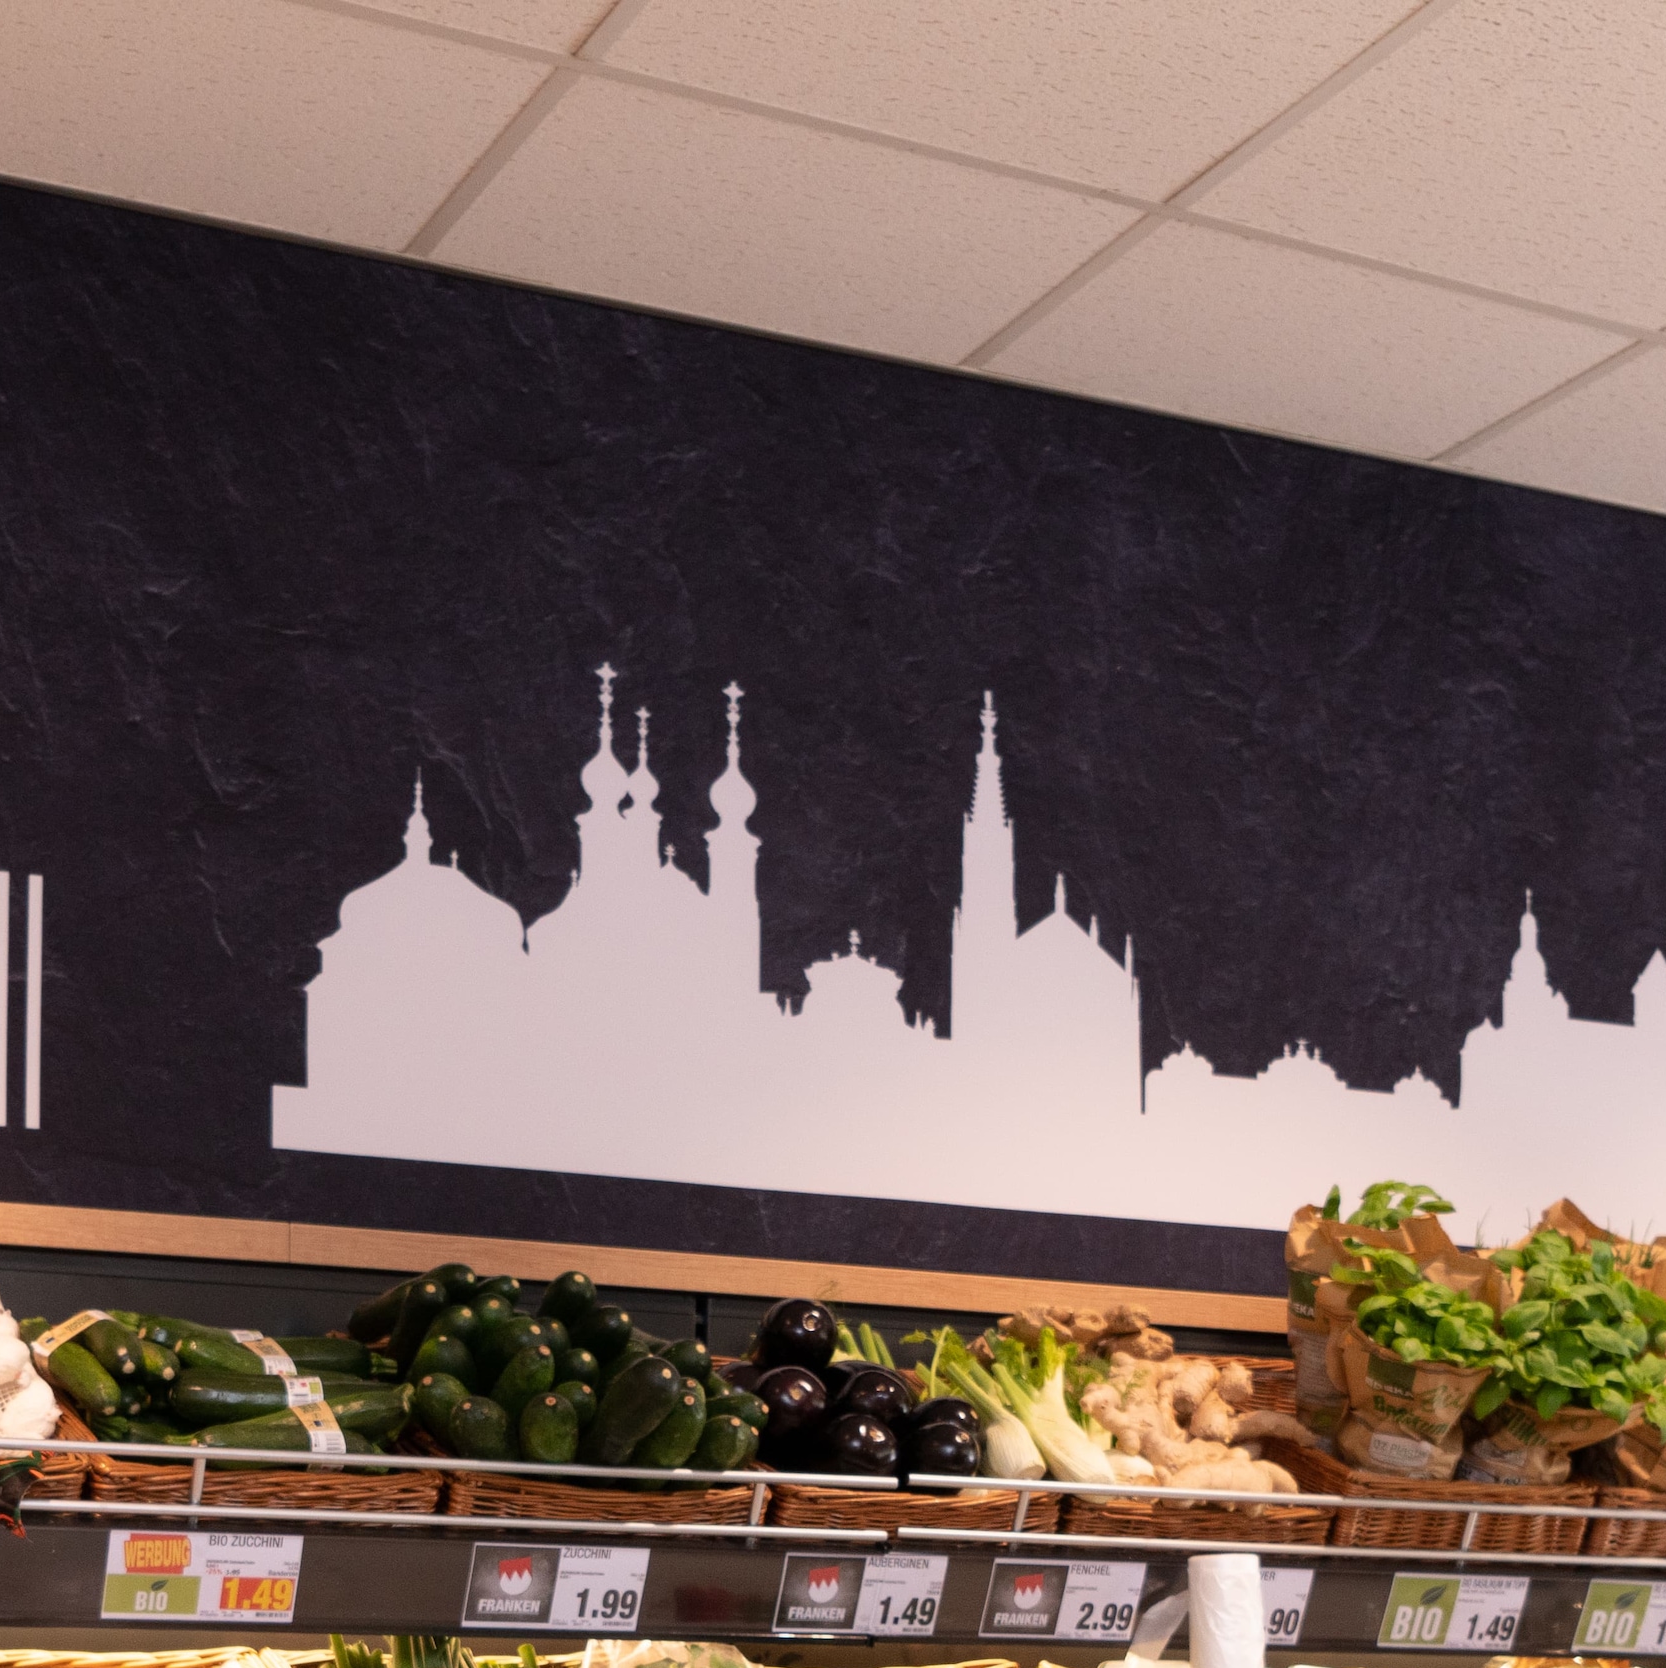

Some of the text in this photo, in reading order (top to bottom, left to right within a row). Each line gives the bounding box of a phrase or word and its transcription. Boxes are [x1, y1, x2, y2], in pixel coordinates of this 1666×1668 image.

[124, 1539, 191, 1569] WERBUNG
[209, 1534, 283, 1549] BIO ZUCCHINI
[563, 1548, 612, 1560] ZUCCHINI
[868, 1556, 930, 1570] AUBERGINEN
[1071, 1564, 1111, 1577] FENCHEL
[135, 1590, 168, 1612] BIO
[224, 1578, 294, 1610] 1.49
[478, 1599, 540, 1613] FRANKEN
[576, 1588, 638, 1619] 1.99
[789, 1606, 845, 1622] FRANKEN
[879, 1596, 935, 1626] 1.49
[994, 1612, 1048, 1628] FRANKEN
[1076, 1603, 1133, 1631] 2.99
[1390, 1605, 1442, 1642] BIO
[1466, 1613, 1516, 1643] 1.49
[1584, 1609, 1636, 1646] BIO
